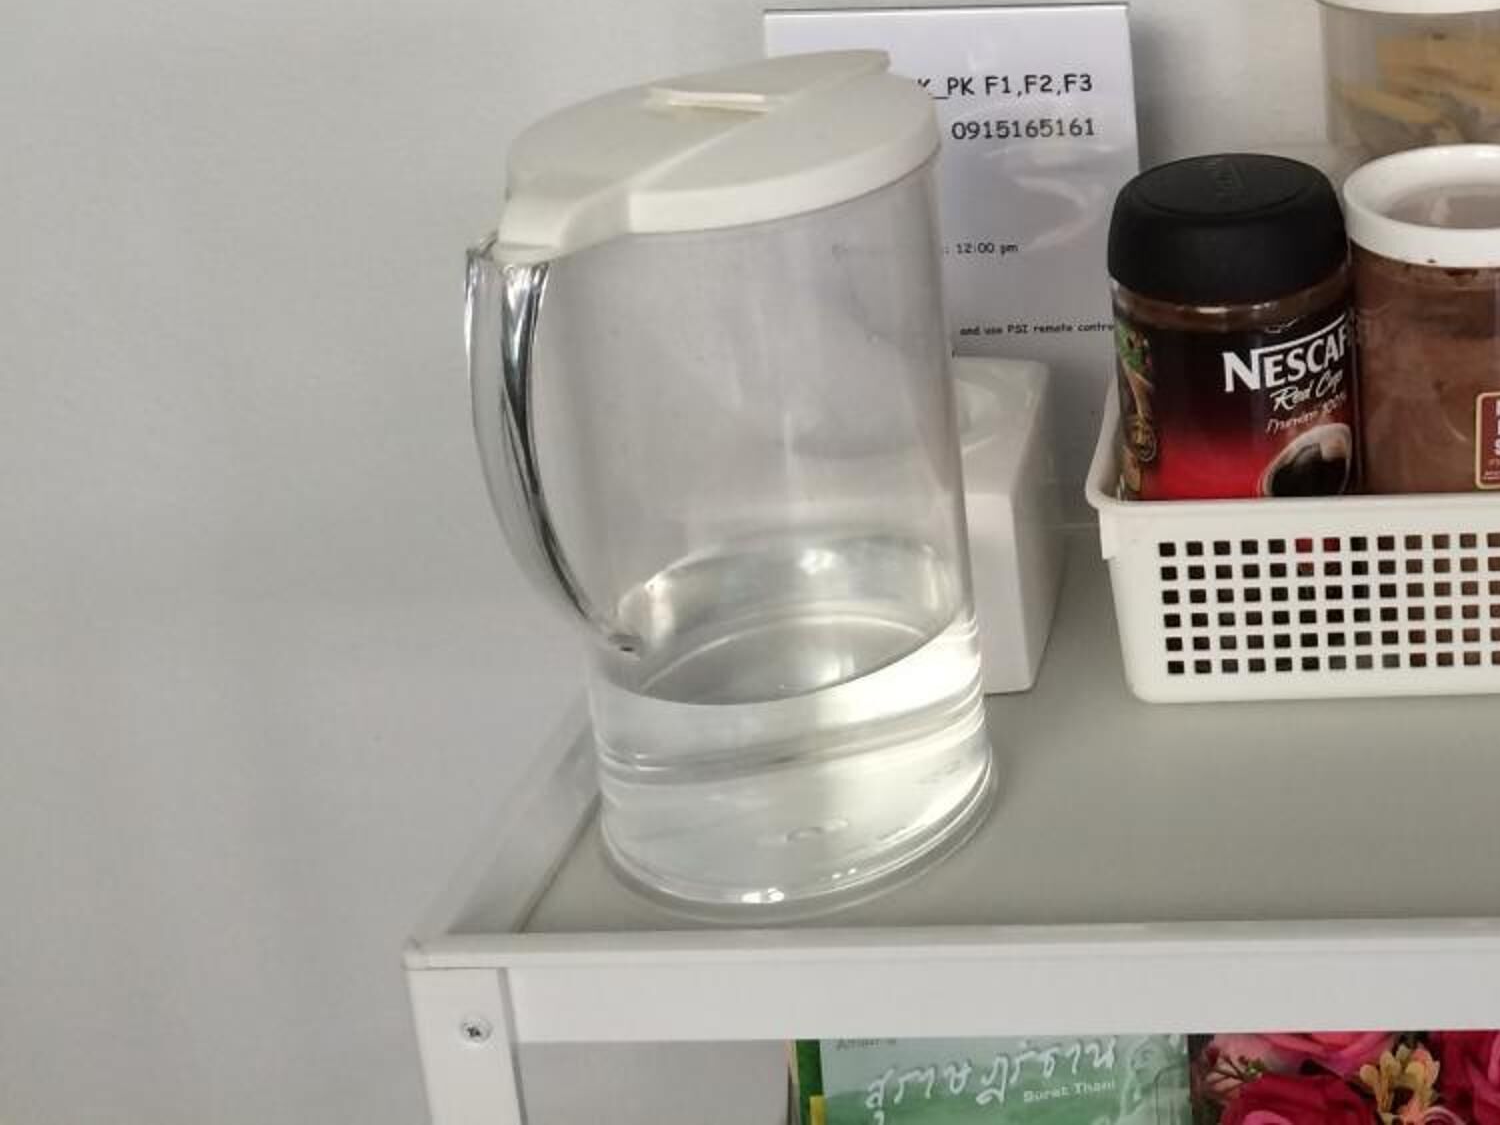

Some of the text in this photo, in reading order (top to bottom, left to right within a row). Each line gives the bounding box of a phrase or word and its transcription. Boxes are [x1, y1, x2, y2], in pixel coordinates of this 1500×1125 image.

[985, 73, 1092, 97] F1,F2,F3
[951, 117, 1095, 140] 0915165161
[1077, 322, 1113, 332] contro
[1222, 313, 1349, 392] NESCAF
[1269, 379, 1314, 411] Red
[1023, 1086, 1070, 1103] Surat
